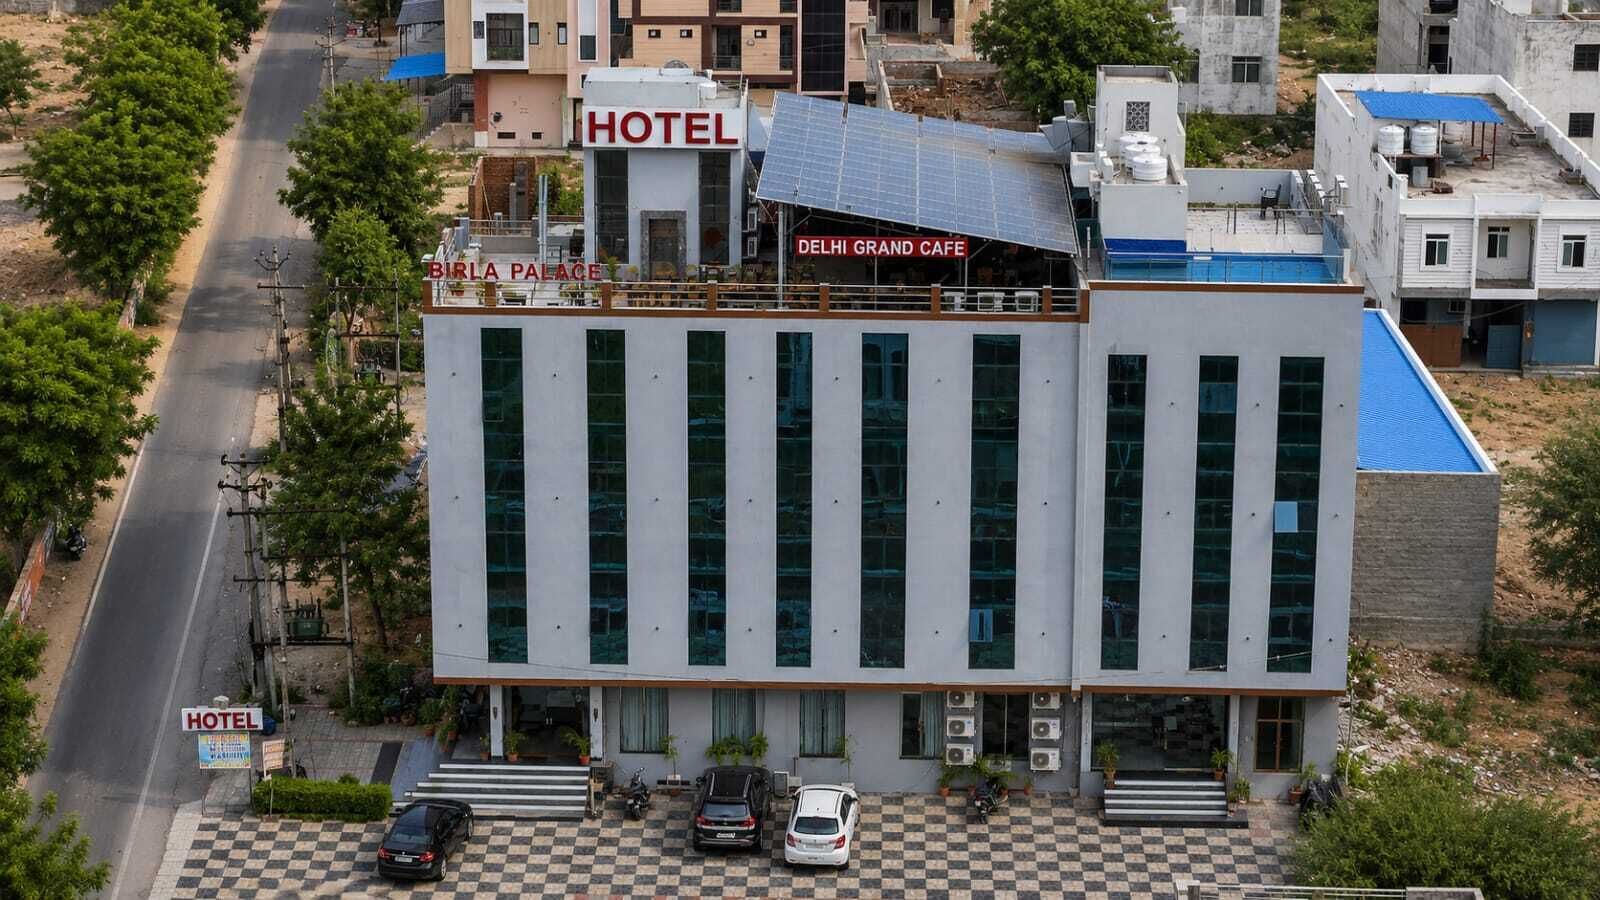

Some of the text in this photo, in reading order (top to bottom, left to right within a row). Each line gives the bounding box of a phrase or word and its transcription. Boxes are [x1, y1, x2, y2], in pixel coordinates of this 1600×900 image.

[587, 111, 739, 145] HOTEL
[798, 239, 966, 256] DELHI GRAND CAFE
[427, 261, 602, 282] BIRLA PALACE
[187, 712, 258, 729] HOTEL
